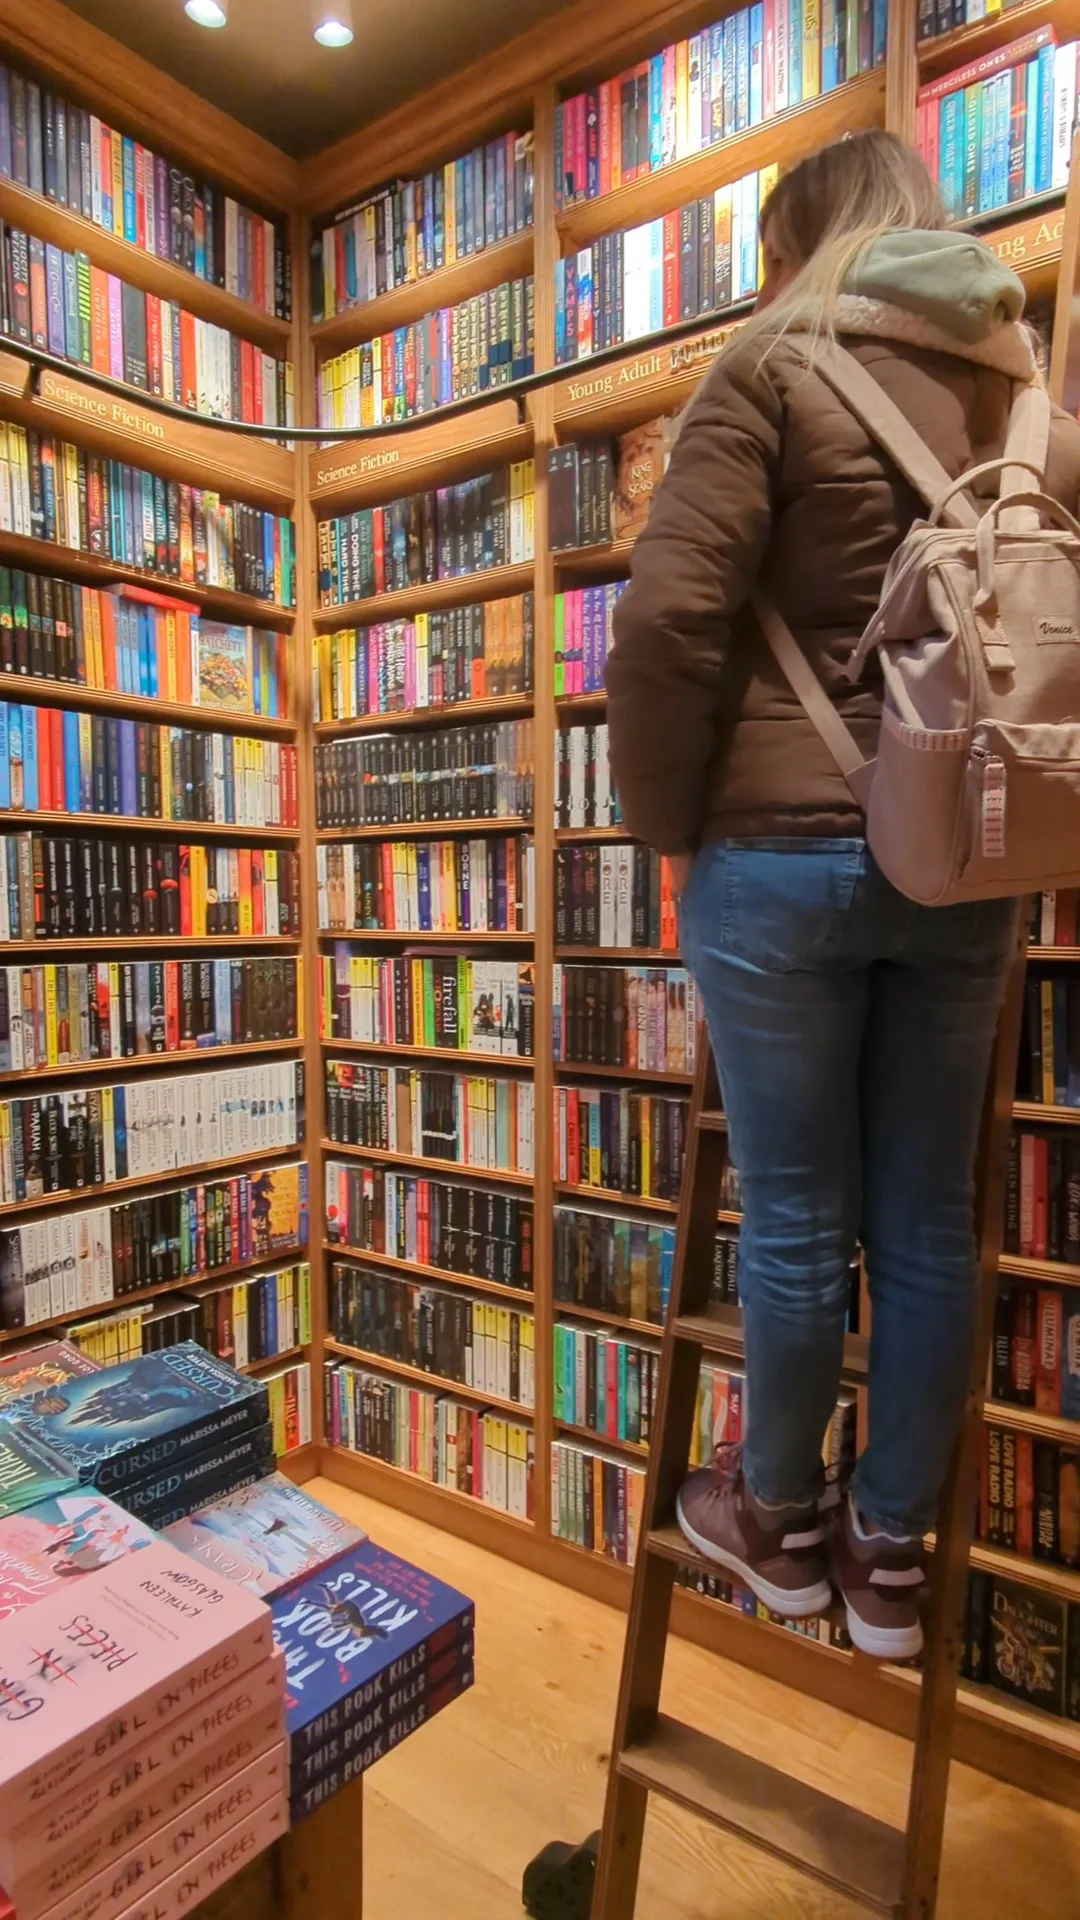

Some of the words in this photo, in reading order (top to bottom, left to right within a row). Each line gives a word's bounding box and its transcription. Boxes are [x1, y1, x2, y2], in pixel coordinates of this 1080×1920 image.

[931, 68, 977, 95] MERCILESS
[979, 53, 1006, 72] ONES
[967, 98, 977, 140] GILDED
[966, 142, 976, 173] ONES
[170, 169, 182, 206] ORCS
[183, 177, 195, 211] ORCS
[12, 230, 21, 281] WEAPON
[19, 231, 28, 284] VELOCITY
[714, 242, 723, 284] BREAKER
[568, 377, 613, 401] Young
[616, 356, 662, 385] Adult
[44, 378, 107, 416] Science
[111, 404, 165, 439] Fiction
[317, 465, 358, 485] Science
[360, 450, 399, 472] Fiction
[341, 538, 349, 566] HARD
[352, 534, 360, 567] DOING
[342, 569, 350, 593] TIME
[353, 569, 361, 591] TIME
[1039, 621, 1074, 635] Venice
[602, 849, 612, 904] LORE
[619, 849, 629, 904] LORE
[508, 901, 516, 925] VOID
[443, 975, 457, 1034] firefall
[89, 1091, 98, 1122] RYAN
[30, 1112, 41, 1151] PARIAH
[76, 1117, 84, 1150] WAKING
[1008, 1152, 1016, 1189] GREEN
[1008, 1192, 1017, 1230] RISING
[162, 1353, 236, 1399] CURSED
[186, 1353, 211, 1372] MEYER
[210, 1367, 241, 1387] MARISSA
[286, 1397, 297, 1418] FALL
[97, 1440, 177, 1486] CURSED
[179, 1423, 220, 1447] MARISSA
[220, 1409, 249, 1428] MEYER
[184, 1457, 225, 1482] MARISSA
[225, 1443, 252, 1463] MEYER
[989, 1430, 1000, 1465] LOVE
[1003, 1434, 1014, 1468] LOVE
[152, 1507, 187, 1531] SED
[189, 1491, 228, 1514] MARISSA
[228, 1475, 257, 1494] MEYER
[989, 1465, 1001, 1504] RADIO
[1003, 1468, 1014, 1508] RADIO
[1045, 1508, 1054, 1550] AURORA
[140, 1580, 204, 1619] KATHLEEN
[160, 1569, 225, 1604] GLASGOW
[326, 1571, 418, 1632] KILLS
[58, 1614, 139, 1673] PIECES
[271, 1596, 374, 1664] BOOK
[28, 1647, 77, 1684] IN
[272, 1629, 325, 1691] THI
[0, 1677, 45, 1721] GIR
[92, 1714, 148, 1757] GIRL
[156, 1692, 181, 1717] IN
[187, 1650, 241, 1696] PIECES
[304, 1710, 338, 1745] THIS
[343, 1679, 385, 1714] BOOK
[389, 1643, 426, 1679] KILLS
[107, 1758, 161, 1800] GIRL
[171, 1731, 195, 1758] IN
[202, 1693, 254, 1736] PIECES
[303, 1742, 338, 1778] THIS
[343, 1709, 384, 1745] BOOK
[389, 1673, 426, 1712] KILLS
[303, 1774, 338, 1811] THIS
[343, 1739, 384, 1777] BOOK
[389, 1703, 426, 1743] KILLS
[109, 1806, 162, 1847] GIRL
[172, 1780, 196, 1806] IN
[203, 1740, 254, 1782] PIECES
[110, 1855, 164, 1900] GIRL
[172, 1828, 196, 1854] IN
[203, 1786, 254, 1829] PIECES
[176, 1879, 200, 1905] IN
[207, 1831, 258, 1879] PIECES
